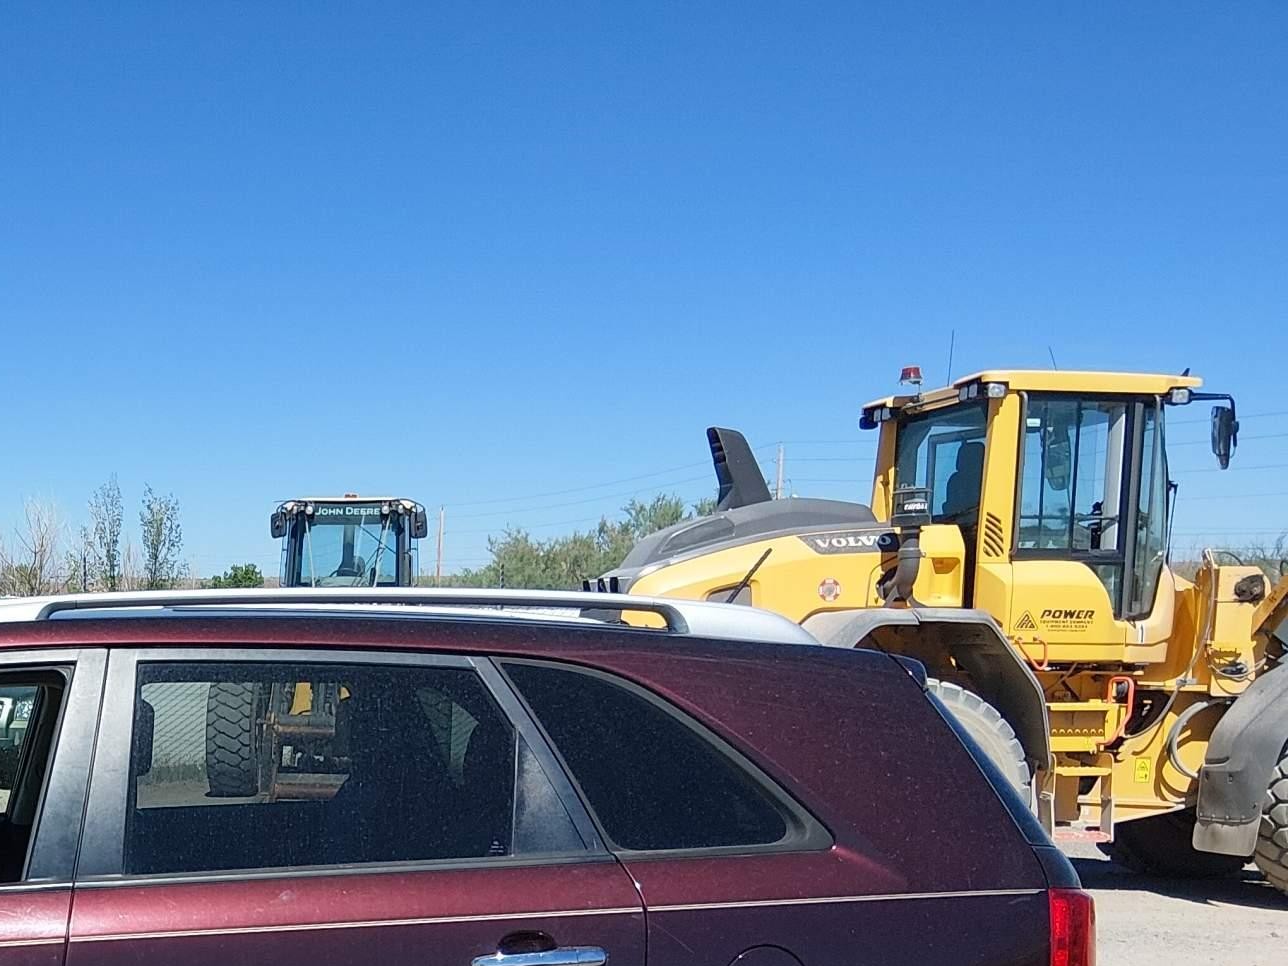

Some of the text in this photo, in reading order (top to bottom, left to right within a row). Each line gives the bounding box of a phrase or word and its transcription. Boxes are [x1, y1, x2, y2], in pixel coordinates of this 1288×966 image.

[314, 506, 381, 516] JOHN DEERE
[815, 535, 892, 548] VOLVO
[1040, 609, 1095, 619] POWER
